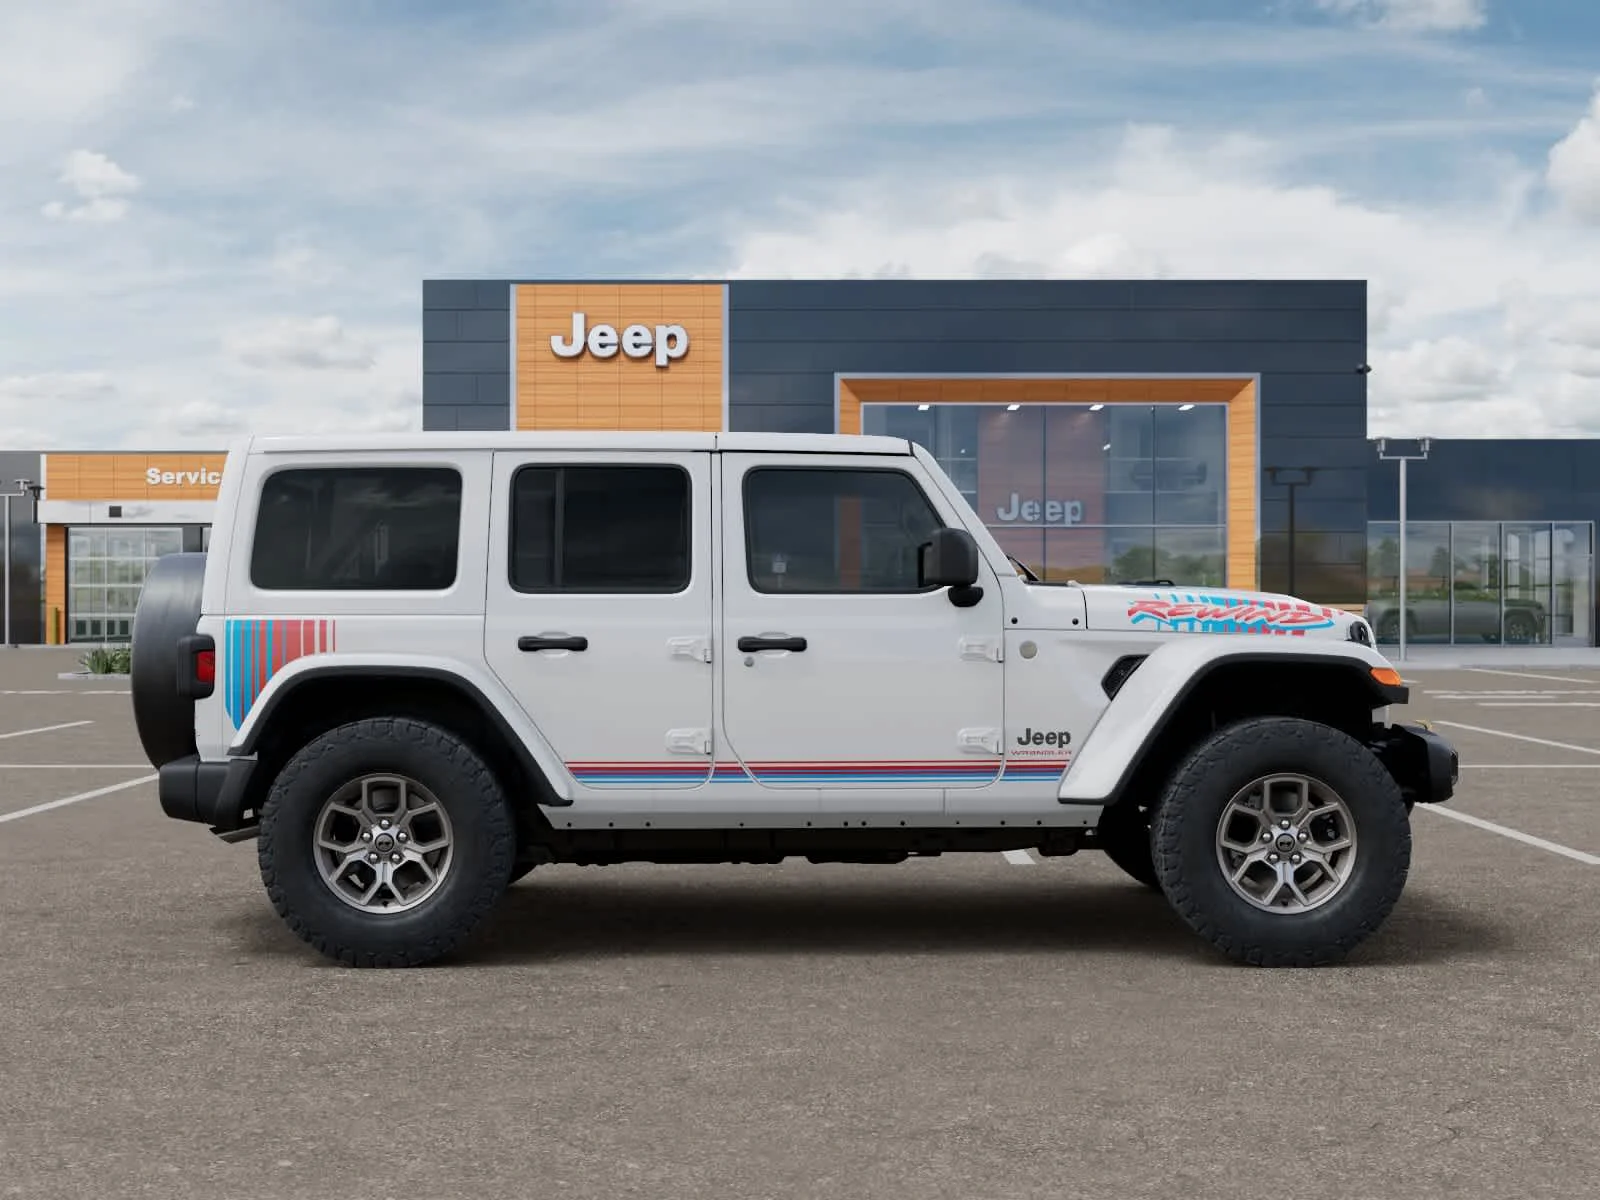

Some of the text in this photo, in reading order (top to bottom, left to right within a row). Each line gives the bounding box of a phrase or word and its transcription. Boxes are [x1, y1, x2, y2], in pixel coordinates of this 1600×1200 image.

[550, 312, 689, 368] Jeep
[146, 467, 222, 485] Servic
[997, 492, 1083, 527] Jeep
[1127, 600, 1327, 625] REWIND
[1017, 727, 1071, 748] Jeep
